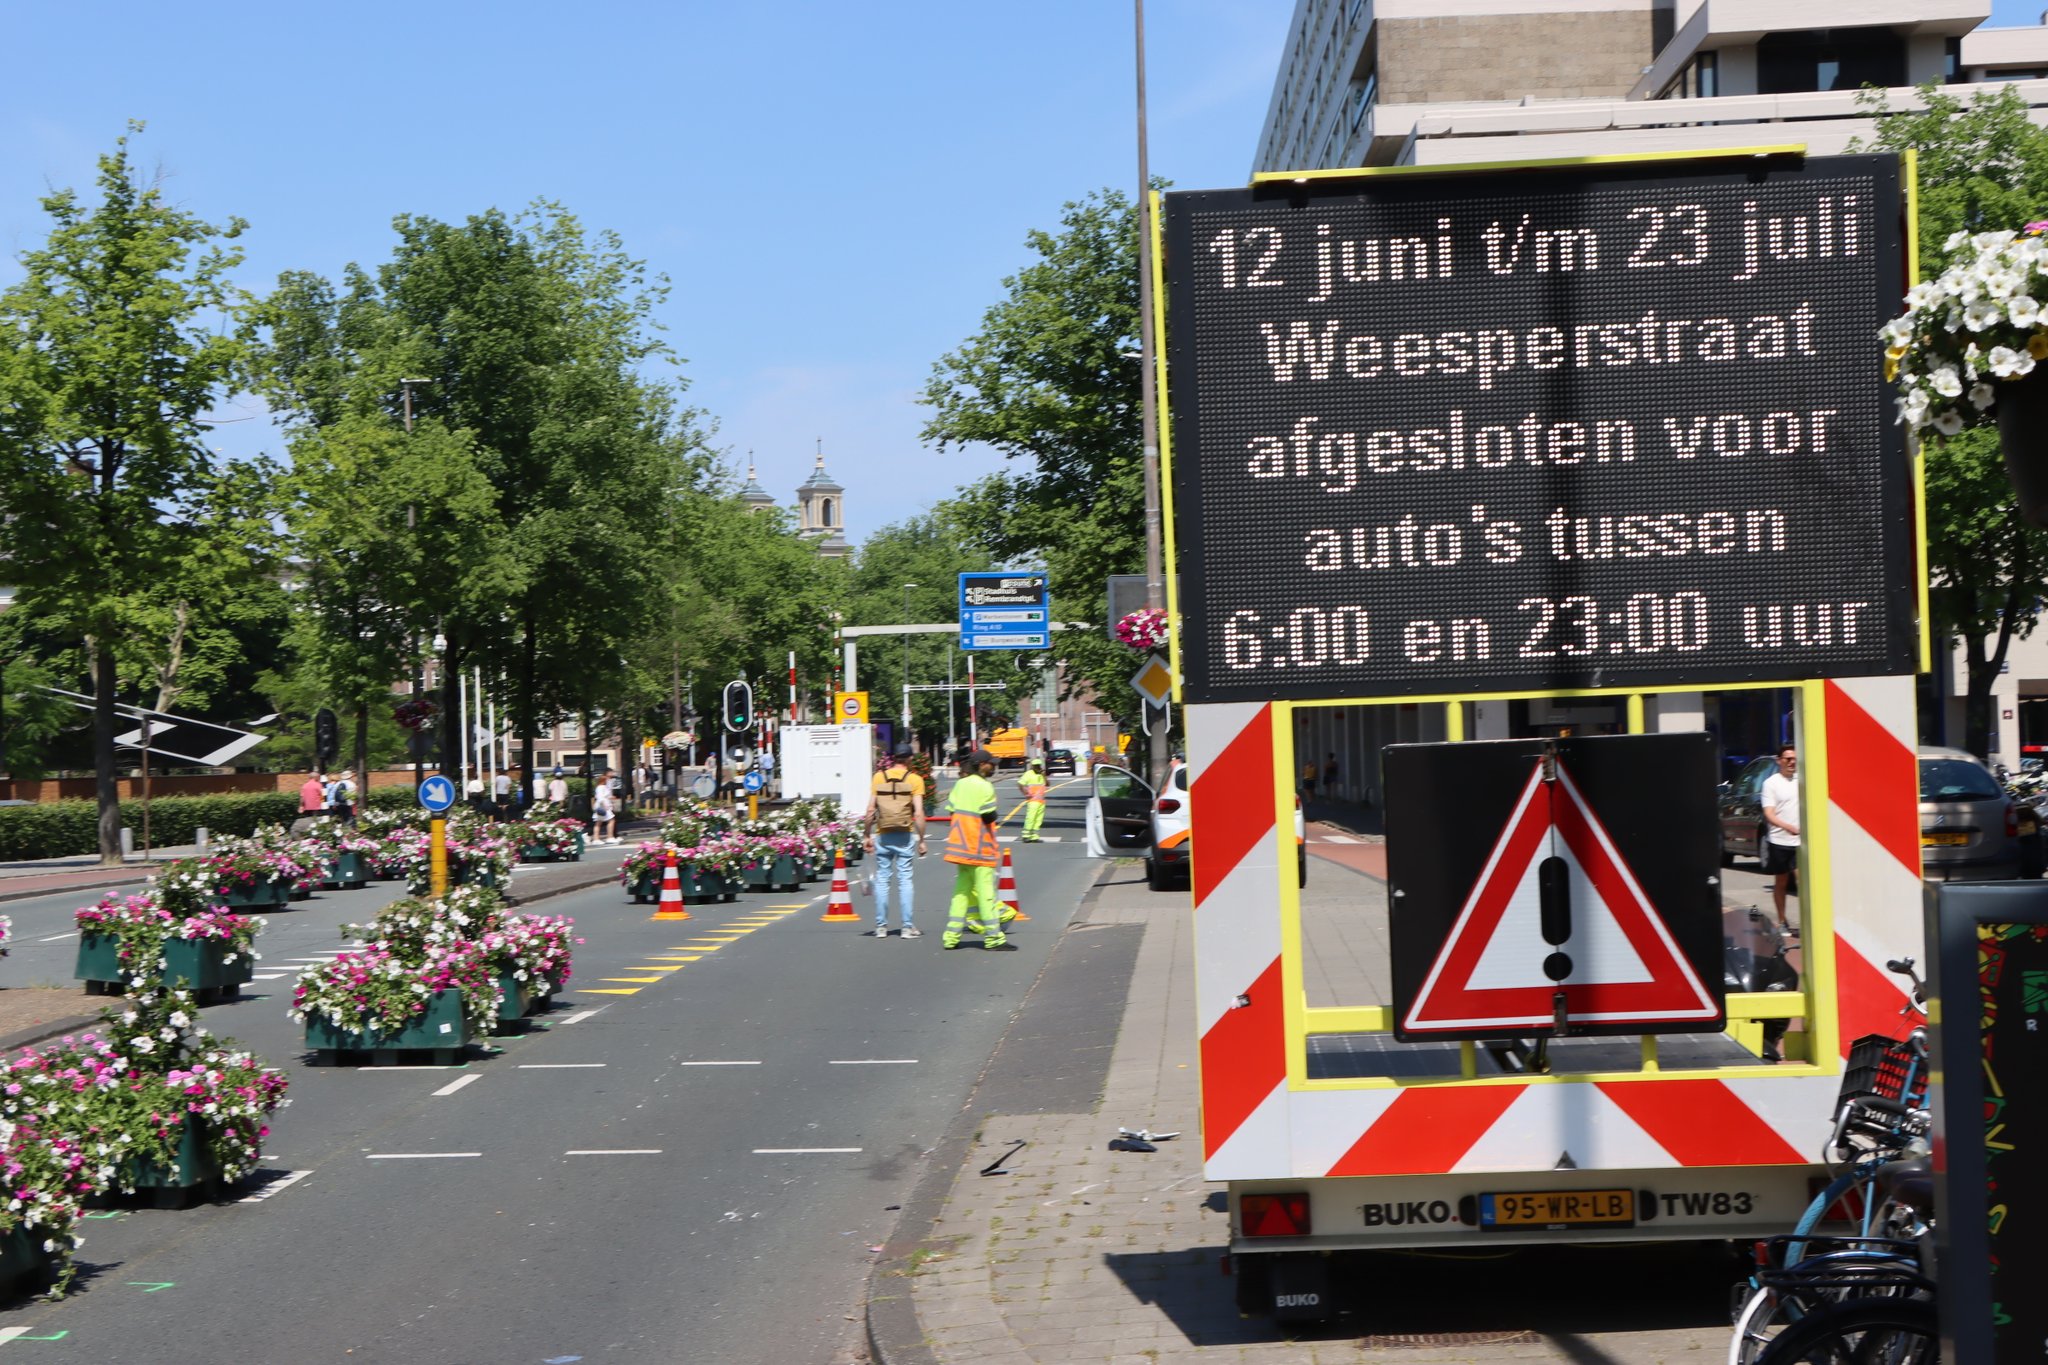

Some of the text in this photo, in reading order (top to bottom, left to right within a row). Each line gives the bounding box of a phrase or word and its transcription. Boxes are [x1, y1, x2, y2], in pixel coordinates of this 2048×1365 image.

[1208, 195, 1858, 302] 12 juni t/m 23 juli
[1260, 301, 1817, 390] Weesperstraat
[1247, 409, 1838, 493] afgesloten voor
[1304, 504, 1786, 571] auto's tussen
[1224, 590, 1868, 669] 6:00 en 23:00 uur
[1502, 1195, 1624, 1220] 95-WR-LB
[1660, 1192, 1753, 1216] TW83
[1276, 1293, 1319, 1307] BUKO
